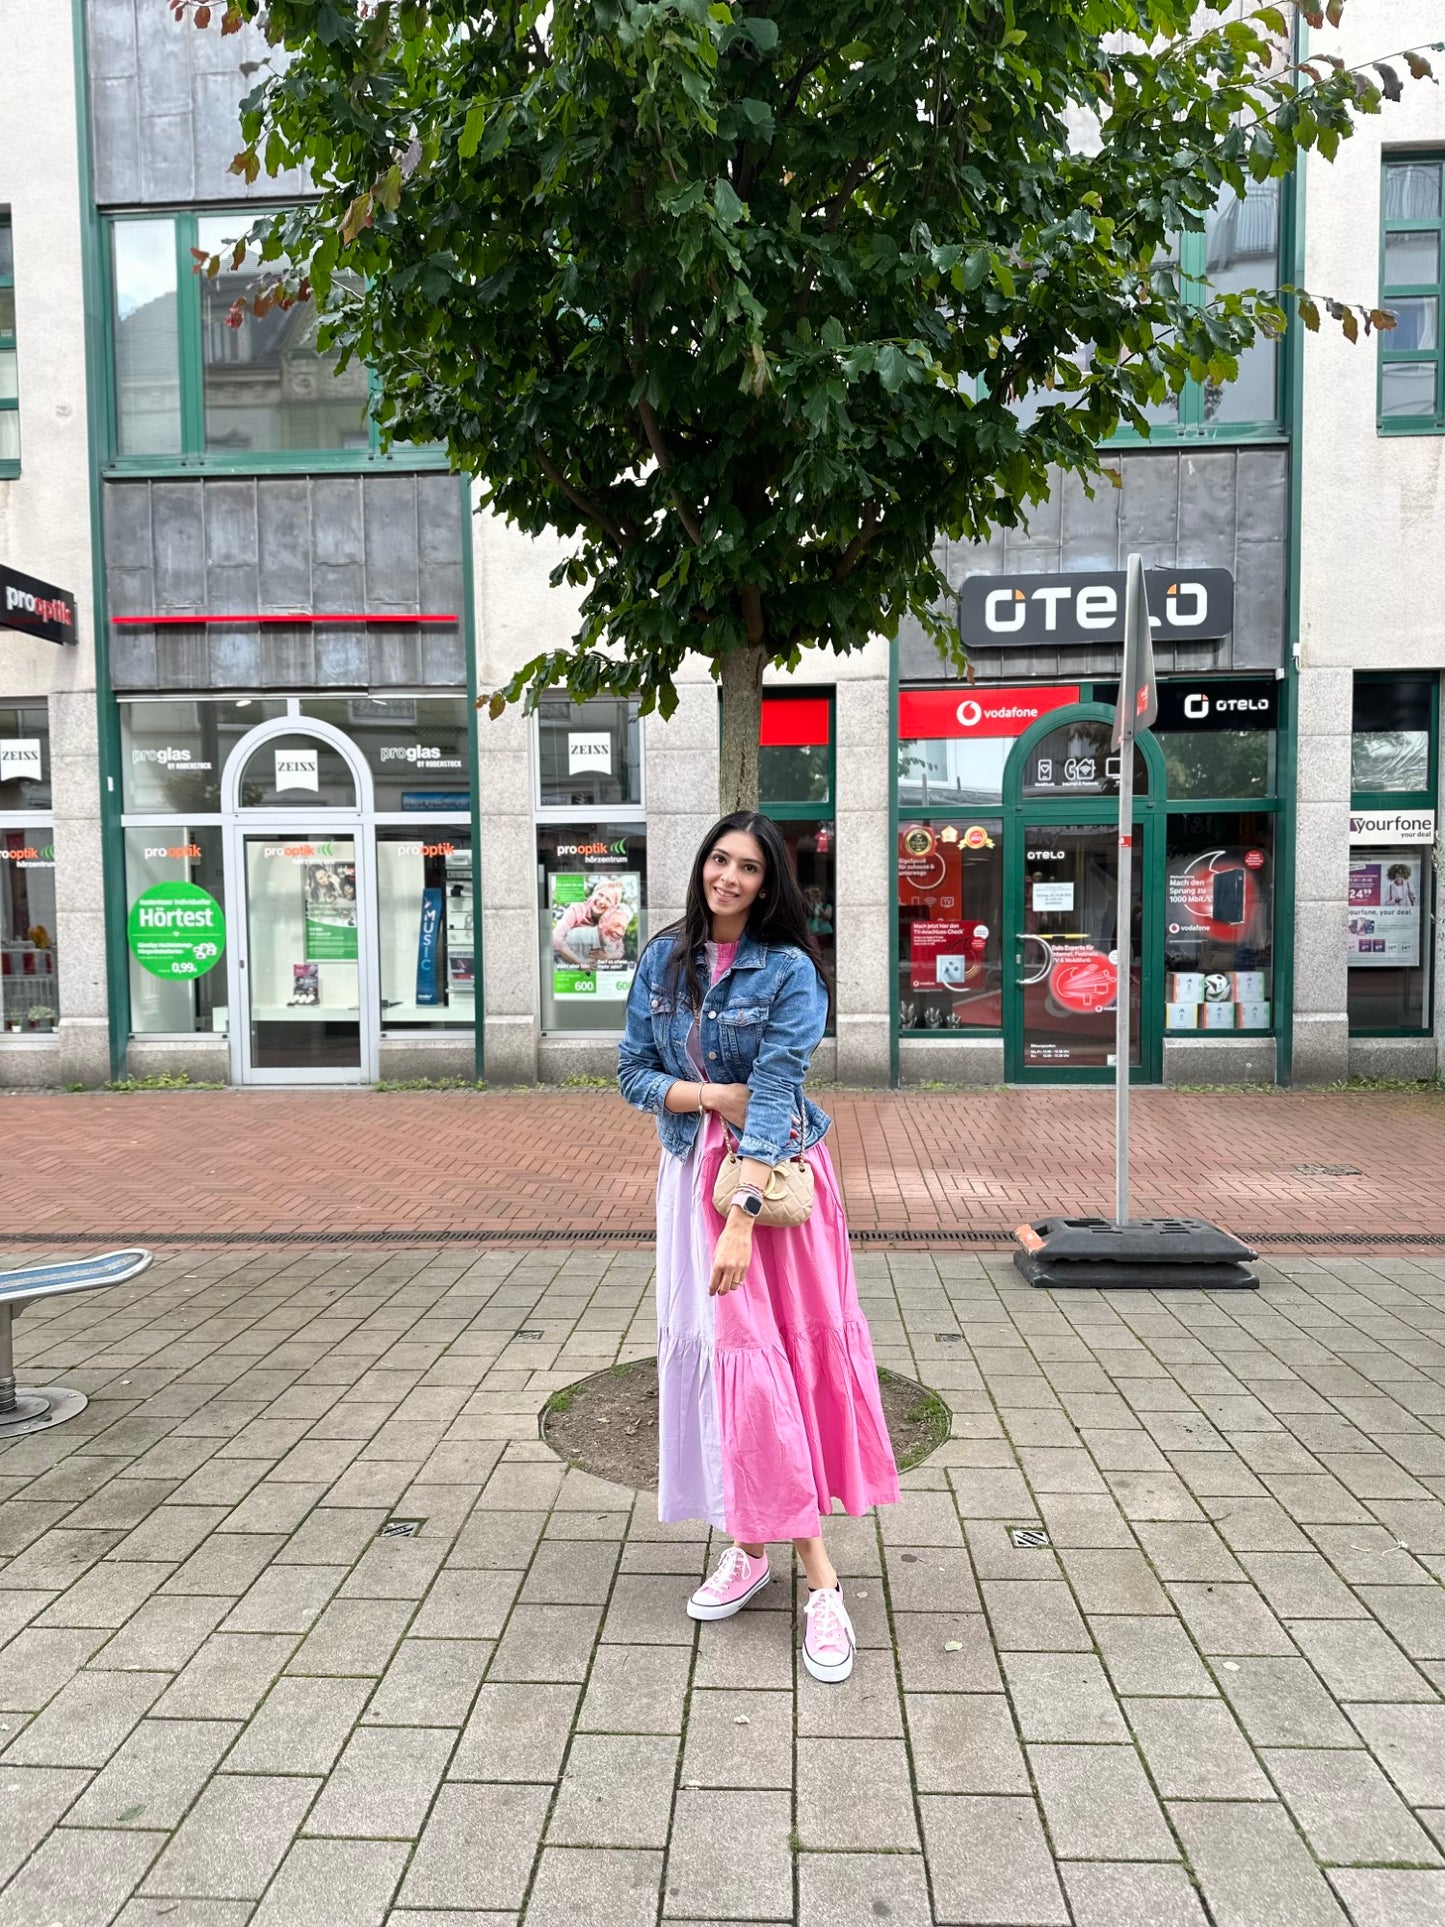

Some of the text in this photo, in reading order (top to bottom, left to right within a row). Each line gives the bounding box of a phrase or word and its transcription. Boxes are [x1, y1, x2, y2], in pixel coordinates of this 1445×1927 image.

[984, 706, 1039, 718] vodafone
[1, 750, 38, 761] ZEISS
[132, 747, 191, 764] proglas
[380, 744, 441, 762] proglas
[569, 744, 609, 755] ZEISS
[176, 762, 212, 770] RODENSTOCK
[277, 761, 316, 772] ZEISS
[417, 760, 462, 768] BY RODENSTOCK
[1356, 816, 1432, 834] yourfone
[0, 848, 38, 861] ooptik
[144, 844, 202, 859] prooptik
[264, 845, 315, 859] prooptik
[398, 843, 455, 858] prooptik
[557, 843, 608, 857] prooptik
[584, 856, 628, 864] hörzentrum
[1169, 887, 1195, 895] Sprung
[139, 907, 214, 927] Hörtest
[420, 910, 437, 971] MUSIC
[574, 981, 594, 992] 600
